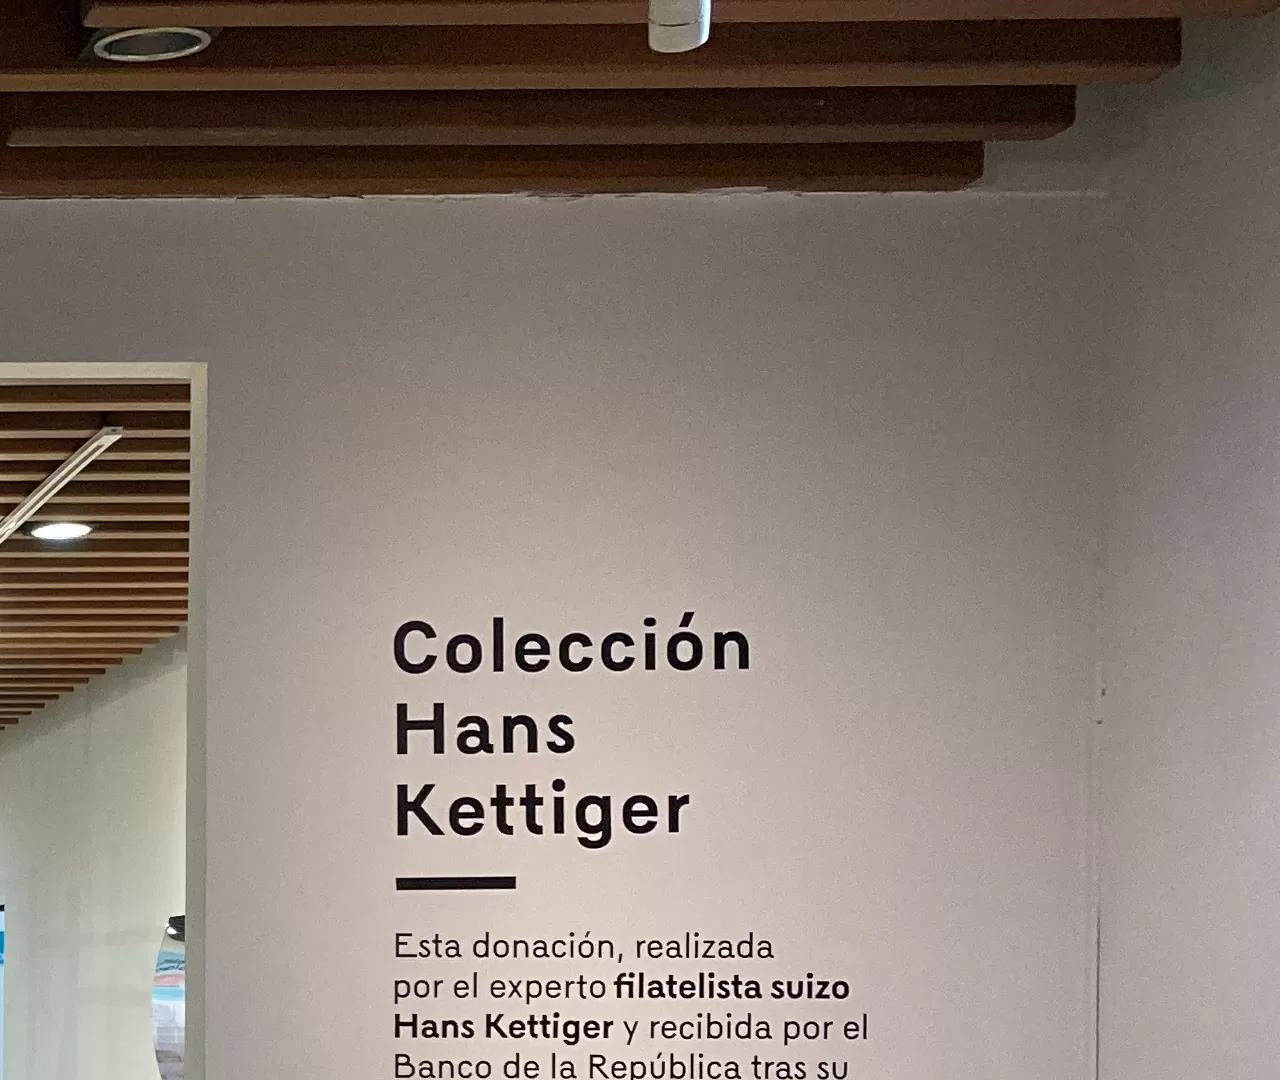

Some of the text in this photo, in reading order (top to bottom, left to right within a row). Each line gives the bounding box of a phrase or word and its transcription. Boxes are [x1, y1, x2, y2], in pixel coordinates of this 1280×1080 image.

[393, 611, 750, 675] Colección
[396, 702, 576, 755] Hans
[396, 778, 690, 850] Kettiger
[395, 930, 775, 964] Esta donación, realizada
[394, 971, 850, 1006] por el experto filatelista suizo
[394, 1011, 868, 1047] Hans Kettiger y recibida por el
[394, 1053, 492, 1079] Banco
[503, 1052, 540, 1080] de
[551, 1052, 578, 1080] la
[750, 1054, 807, 1080] tras
[816, 1061, 848, 1080] su
